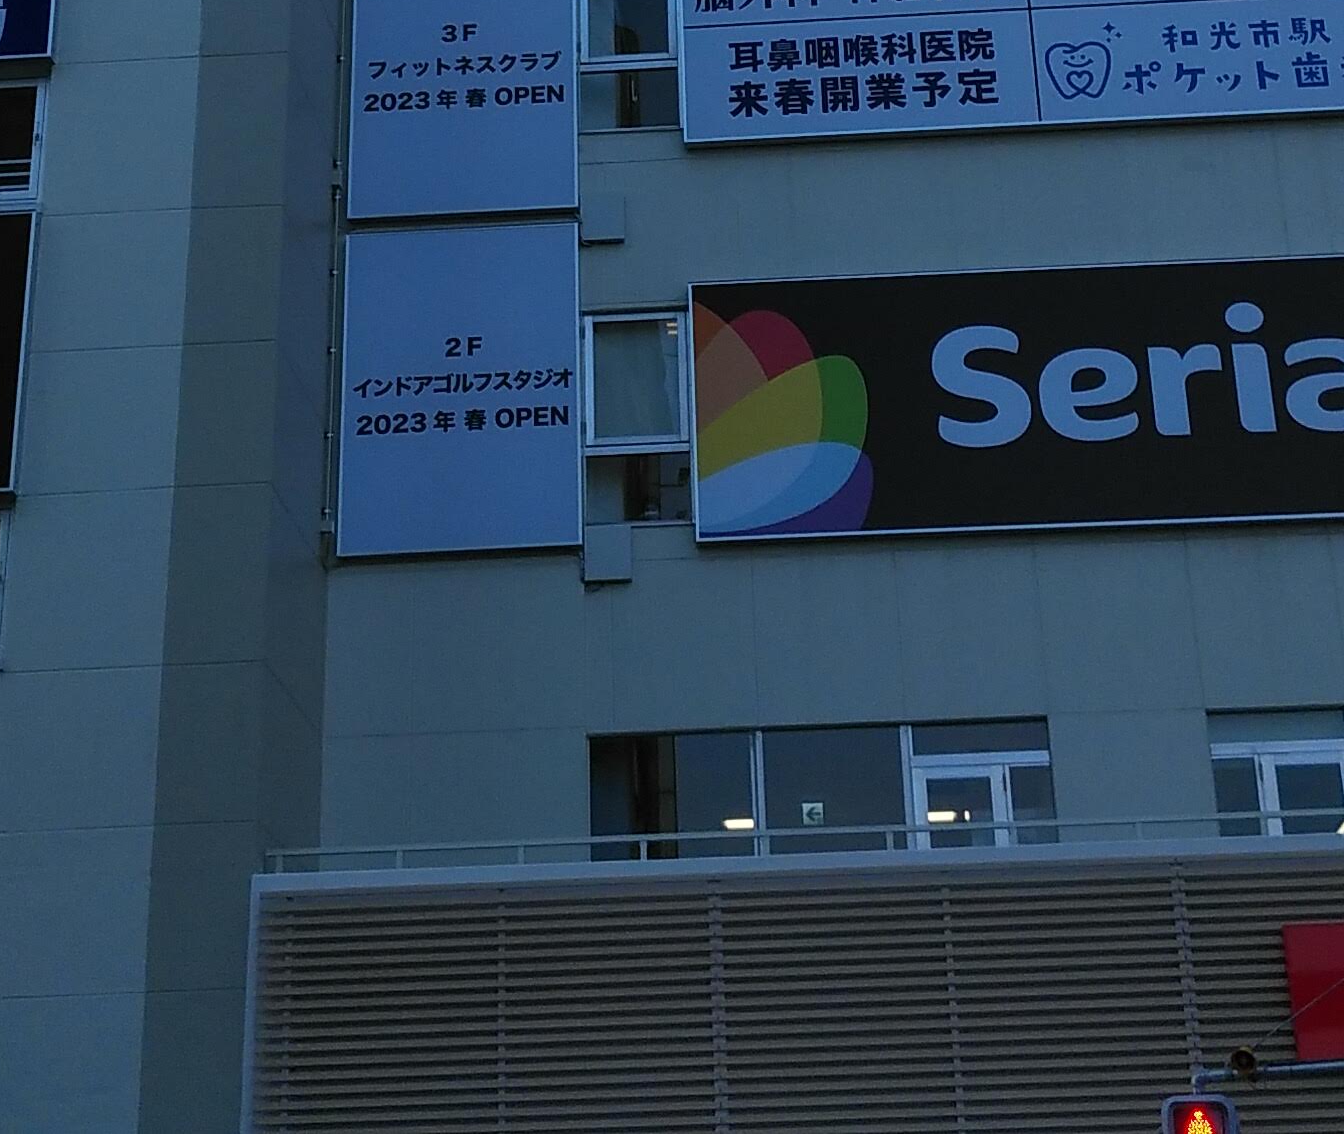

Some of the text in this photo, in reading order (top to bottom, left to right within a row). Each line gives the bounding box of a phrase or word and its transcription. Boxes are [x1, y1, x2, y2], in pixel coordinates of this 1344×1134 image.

[441, 23, 478, 43] 3F
[1162, 17, 1331, 54] 和光市駅
[367, 49, 563, 79] フィットネスクラブ
[728, 27, 996, 73] 耳鼻咽喉科医院
[728, 69, 1000, 117] 来春開業予定
[444, 336, 483, 358] 2F
[353, 368, 574, 399] インドアゴルフスタジオ
